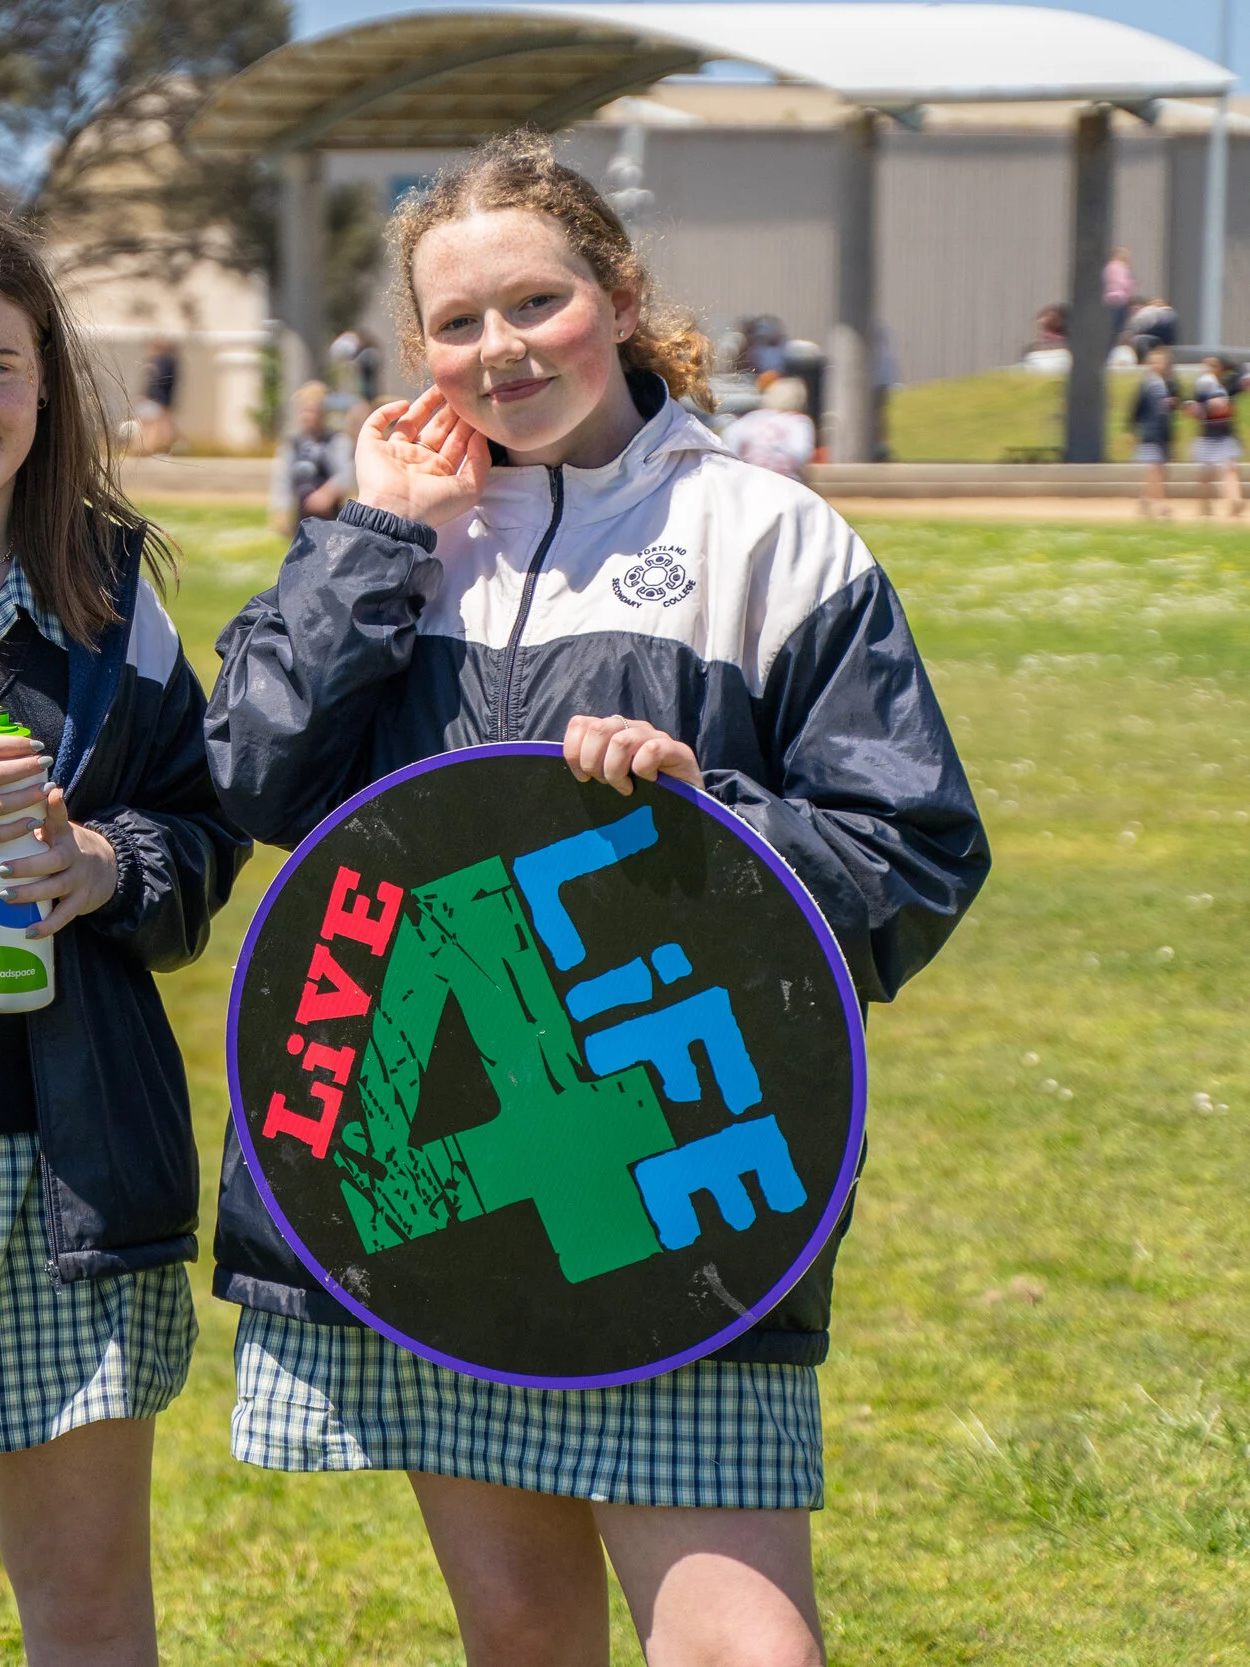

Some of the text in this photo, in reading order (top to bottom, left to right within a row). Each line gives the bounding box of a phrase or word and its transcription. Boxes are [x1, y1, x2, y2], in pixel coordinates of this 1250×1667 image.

[637, 545, 687, 558] PORTLAND
[612, 578, 696, 608] SECONDARY COLLEGE
[332, 854, 677, 1284] 4
